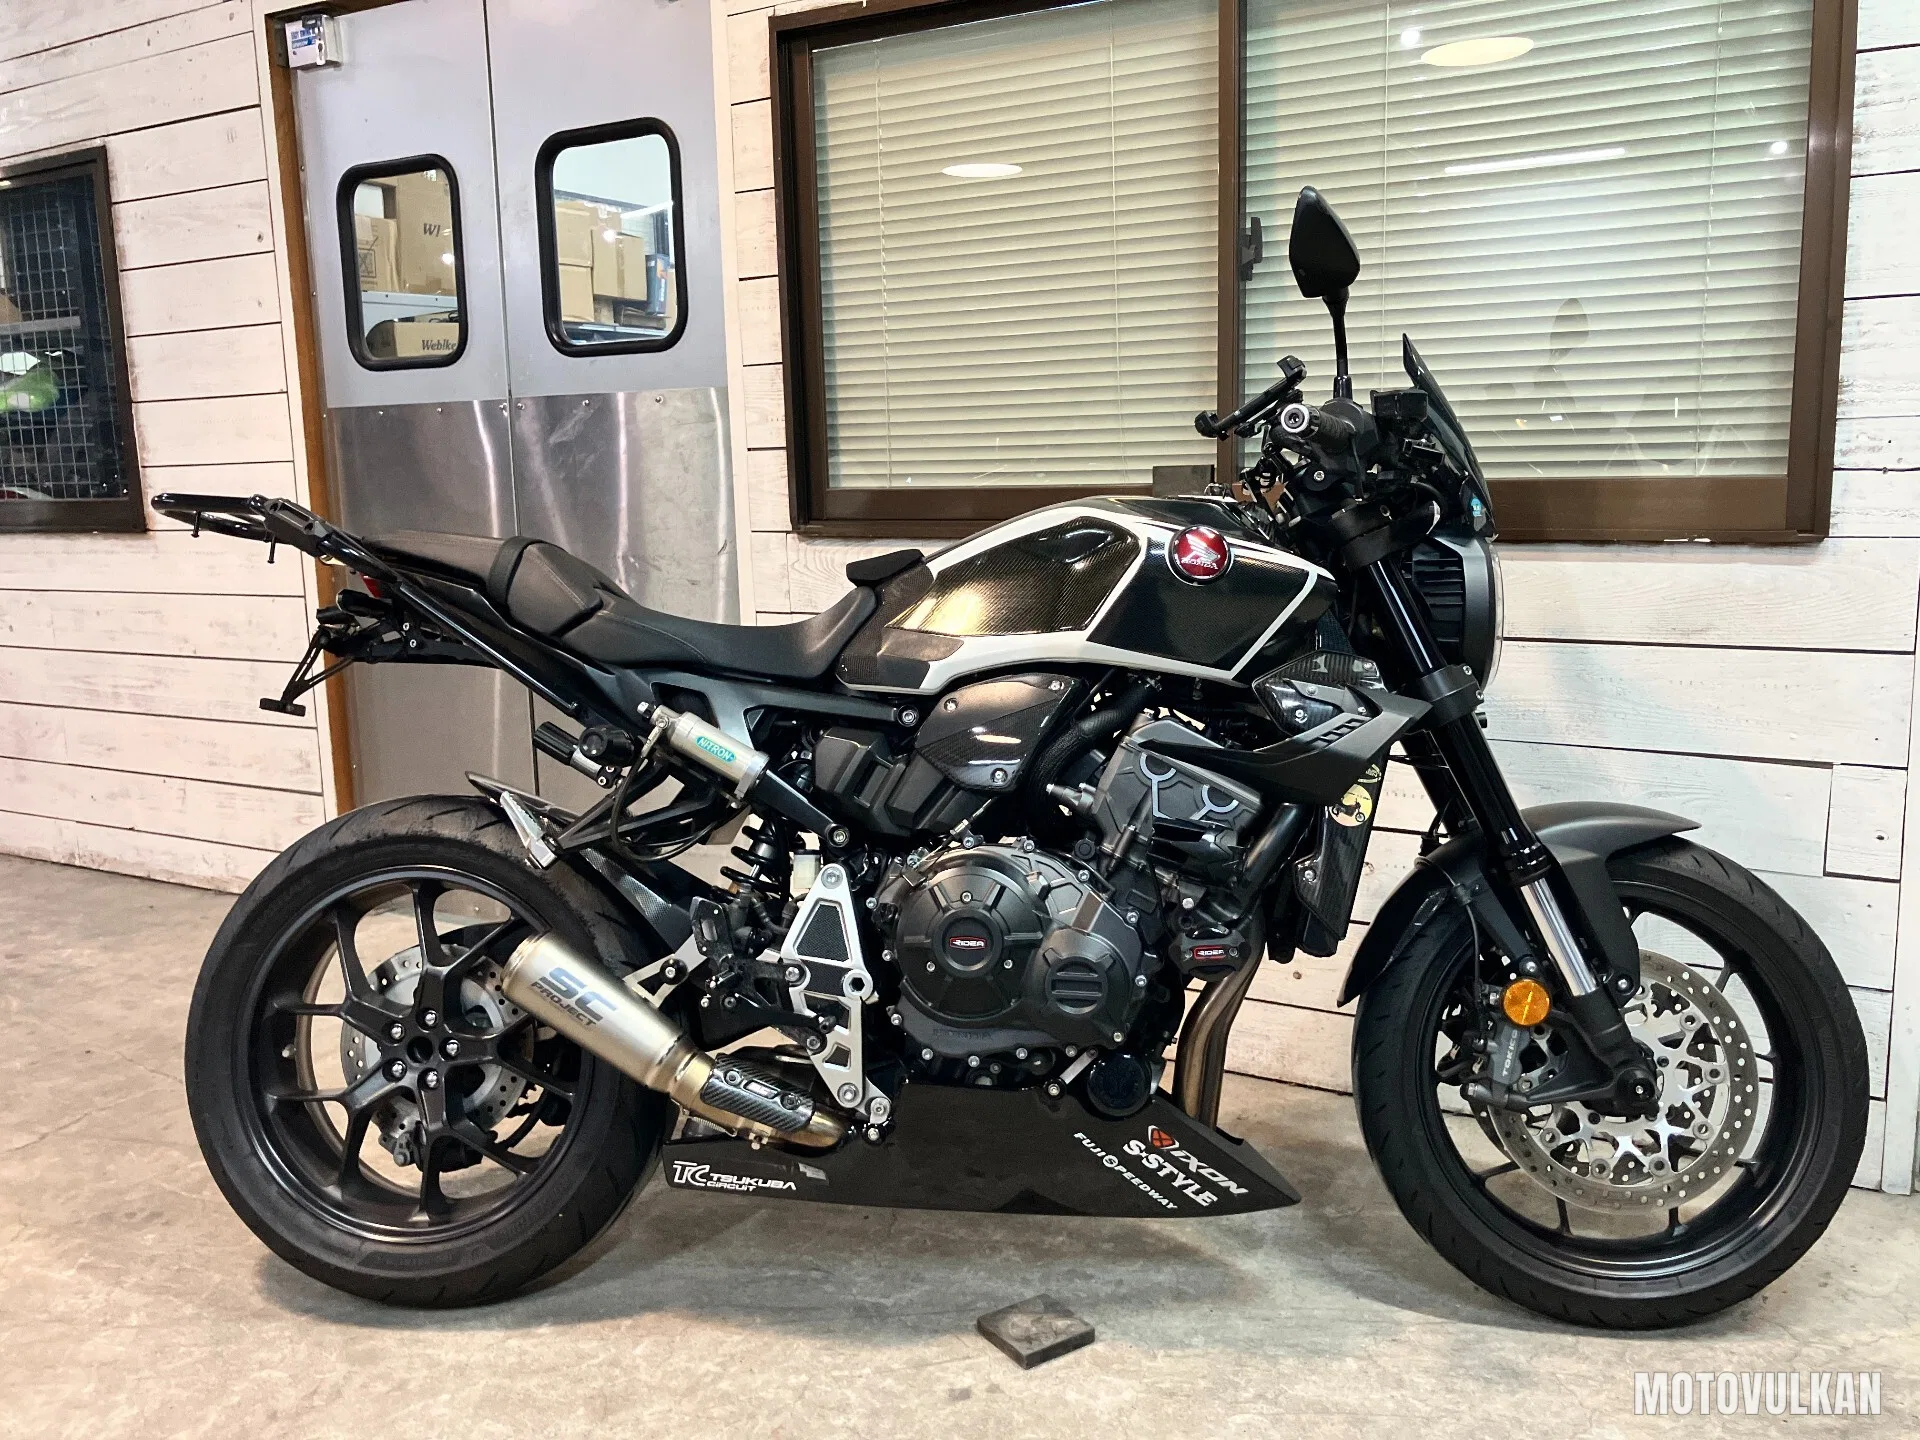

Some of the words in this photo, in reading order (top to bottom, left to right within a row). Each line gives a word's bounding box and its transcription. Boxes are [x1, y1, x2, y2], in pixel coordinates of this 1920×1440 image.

[697, 737, 733, 761] NITRON
[952, 939, 985, 948] RIDEA
[530, 981, 597, 1026] PROJECT
[538, 967, 617, 1022] SC
[1502, 1029, 1518, 1077] TOKICO
[709, 1172, 797, 1191] TSUKUBA
